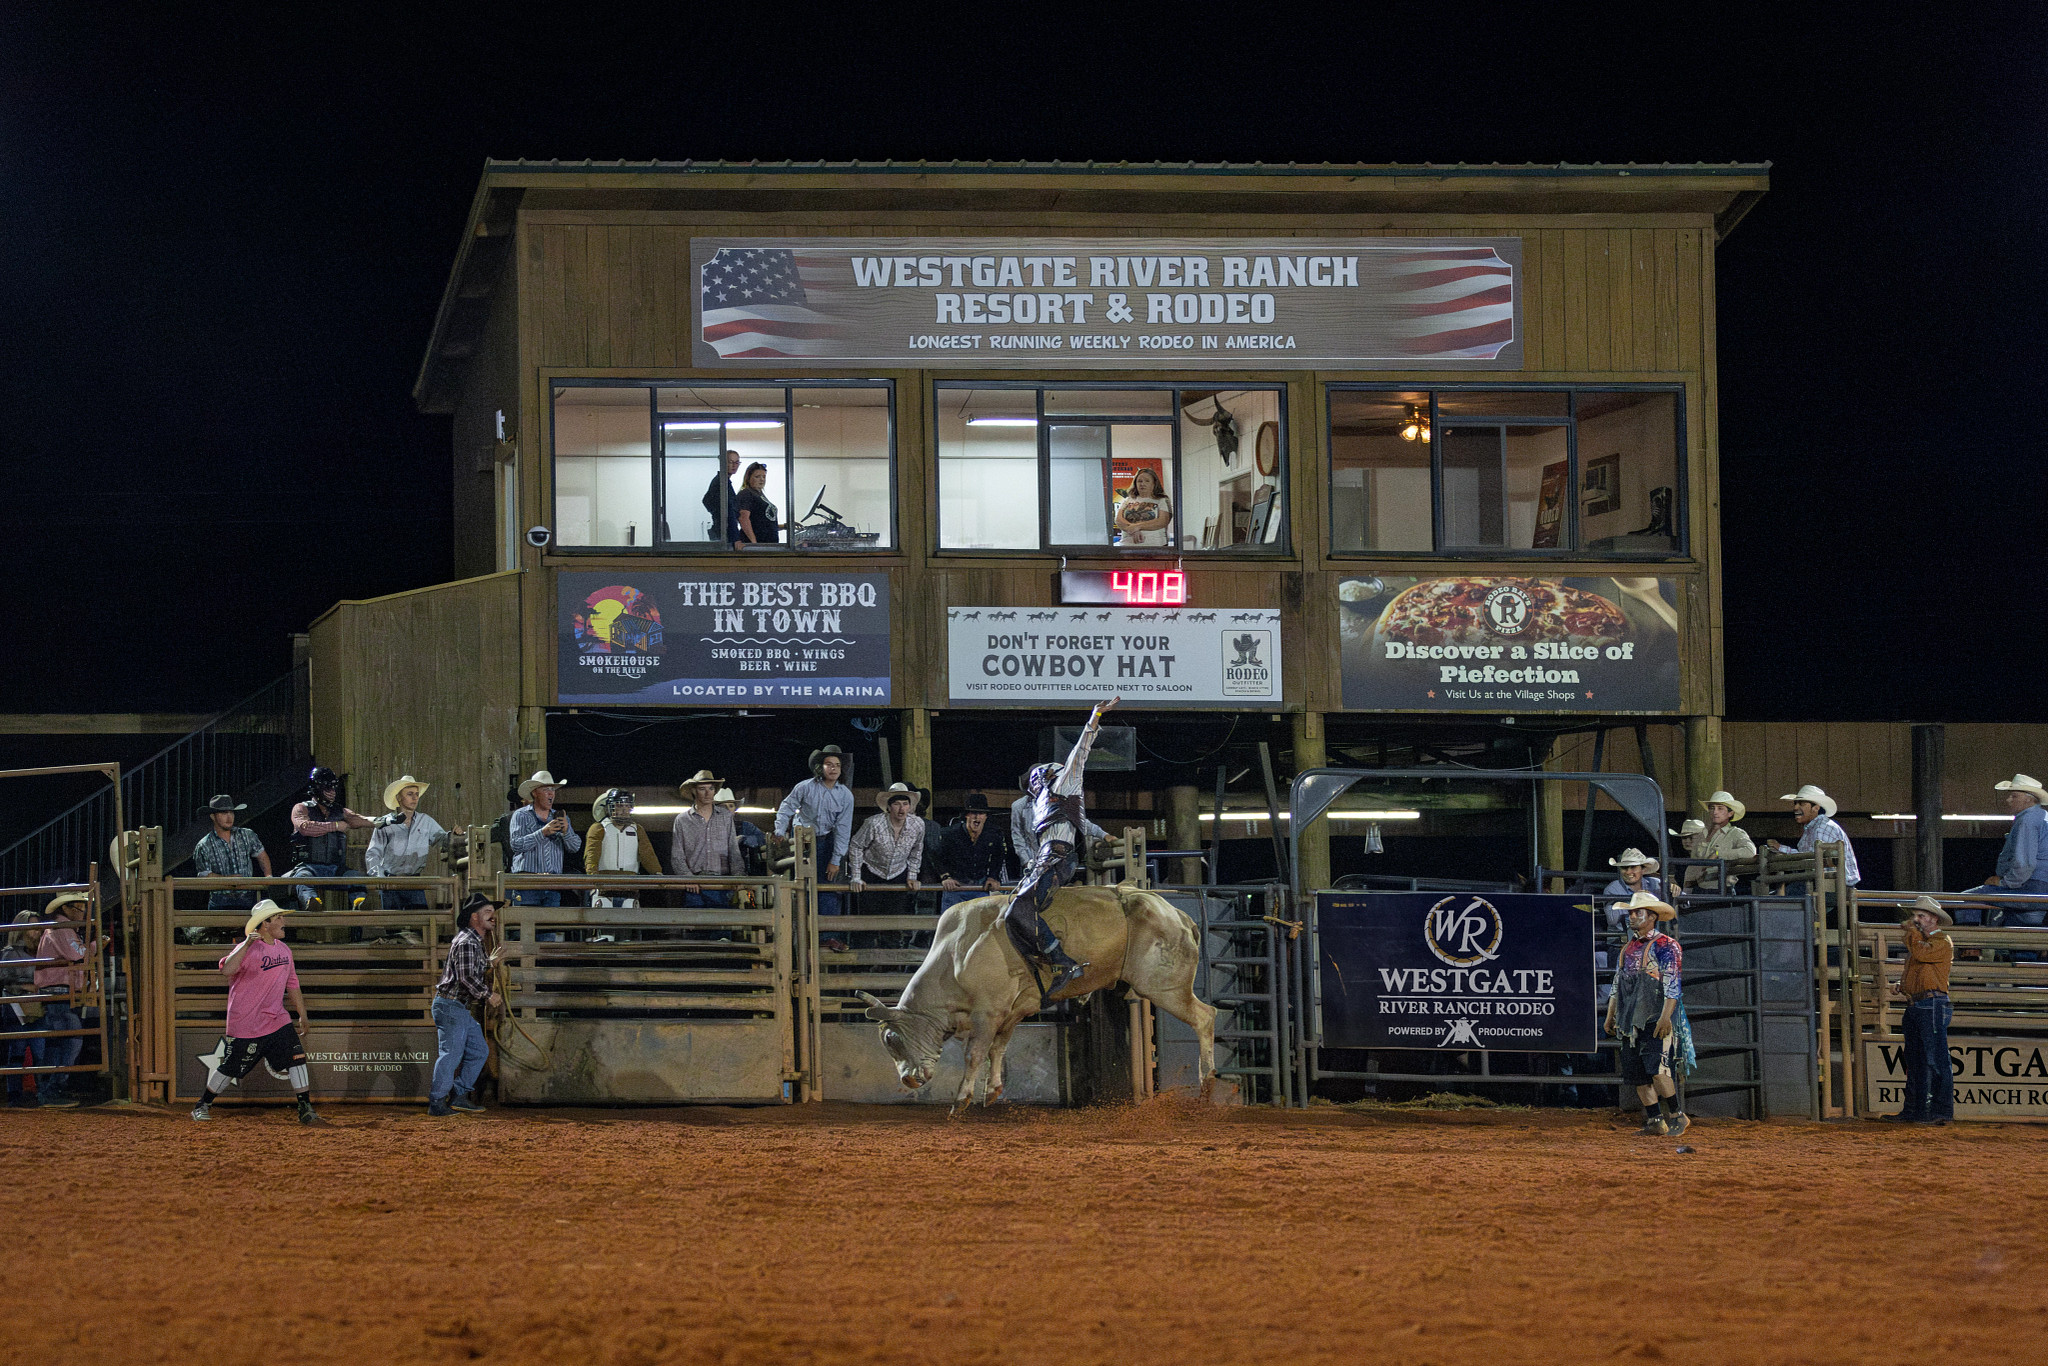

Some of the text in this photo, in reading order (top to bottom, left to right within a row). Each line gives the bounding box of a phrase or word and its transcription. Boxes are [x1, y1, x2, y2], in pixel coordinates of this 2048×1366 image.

[852, 257, 1359, 287] WESTGATE RIVER RANCH
[935, 293, 1275, 324] RESORT & RODEO
[909, 335, 1297, 349] LONGEST RUNNING WEEKLY RODEO IN AMERICA
[1112, 572, 1183, 603] 4.08
[678, 582, 877, 608] THE BEST BBQ
[713, 608, 843, 634] IN TOWN
[987, 632, 1170, 650] DON'T FORGET YOUR
[711, 648, 845, 660] SMOKED BBQ WINGS
[1385, 641, 1635, 661] Discover a Slice of
[578, 655, 660, 666] SMOKEHOUSE
[739, 661, 818, 671] BEER WINE
[982, 654, 1176, 678] COWBOY HAT
[592, 666, 603, 674] ON
[622, 667, 647, 677] RIVER
[1226, 668, 1268, 680] RODEO
[1439, 665, 1580, 684] Piefection
[673, 685, 885, 697] LOCATED BY THE MARINA
[966, 683, 988, 691] VISIT
[990, 683, 1022, 691] RODEO
[1024, 683, 1072, 691] OUTFITTER
[1074, 684, 1114, 692] LOCATED
[1117, 684, 1139, 692] NEXT
[1445, 689, 1575, 702] Visit Us at the Village Shops
[1378, 968, 1555, 994] WESTGATE
[1379, 1001, 1555, 1016] RIVER RANCH RODEO
[1388, 1027, 1543, 1037] POWERED BY PRODUCTIONS
[306, 1052, 360, 1060] WESTGATE
[362, 1052, 391, 1061] RIVER
[394, 1052, 429, 1061] RANCH
[1878, 1045, 2048, 1078] WSTGA
[333, 1064, 364, 1072] RESORT
